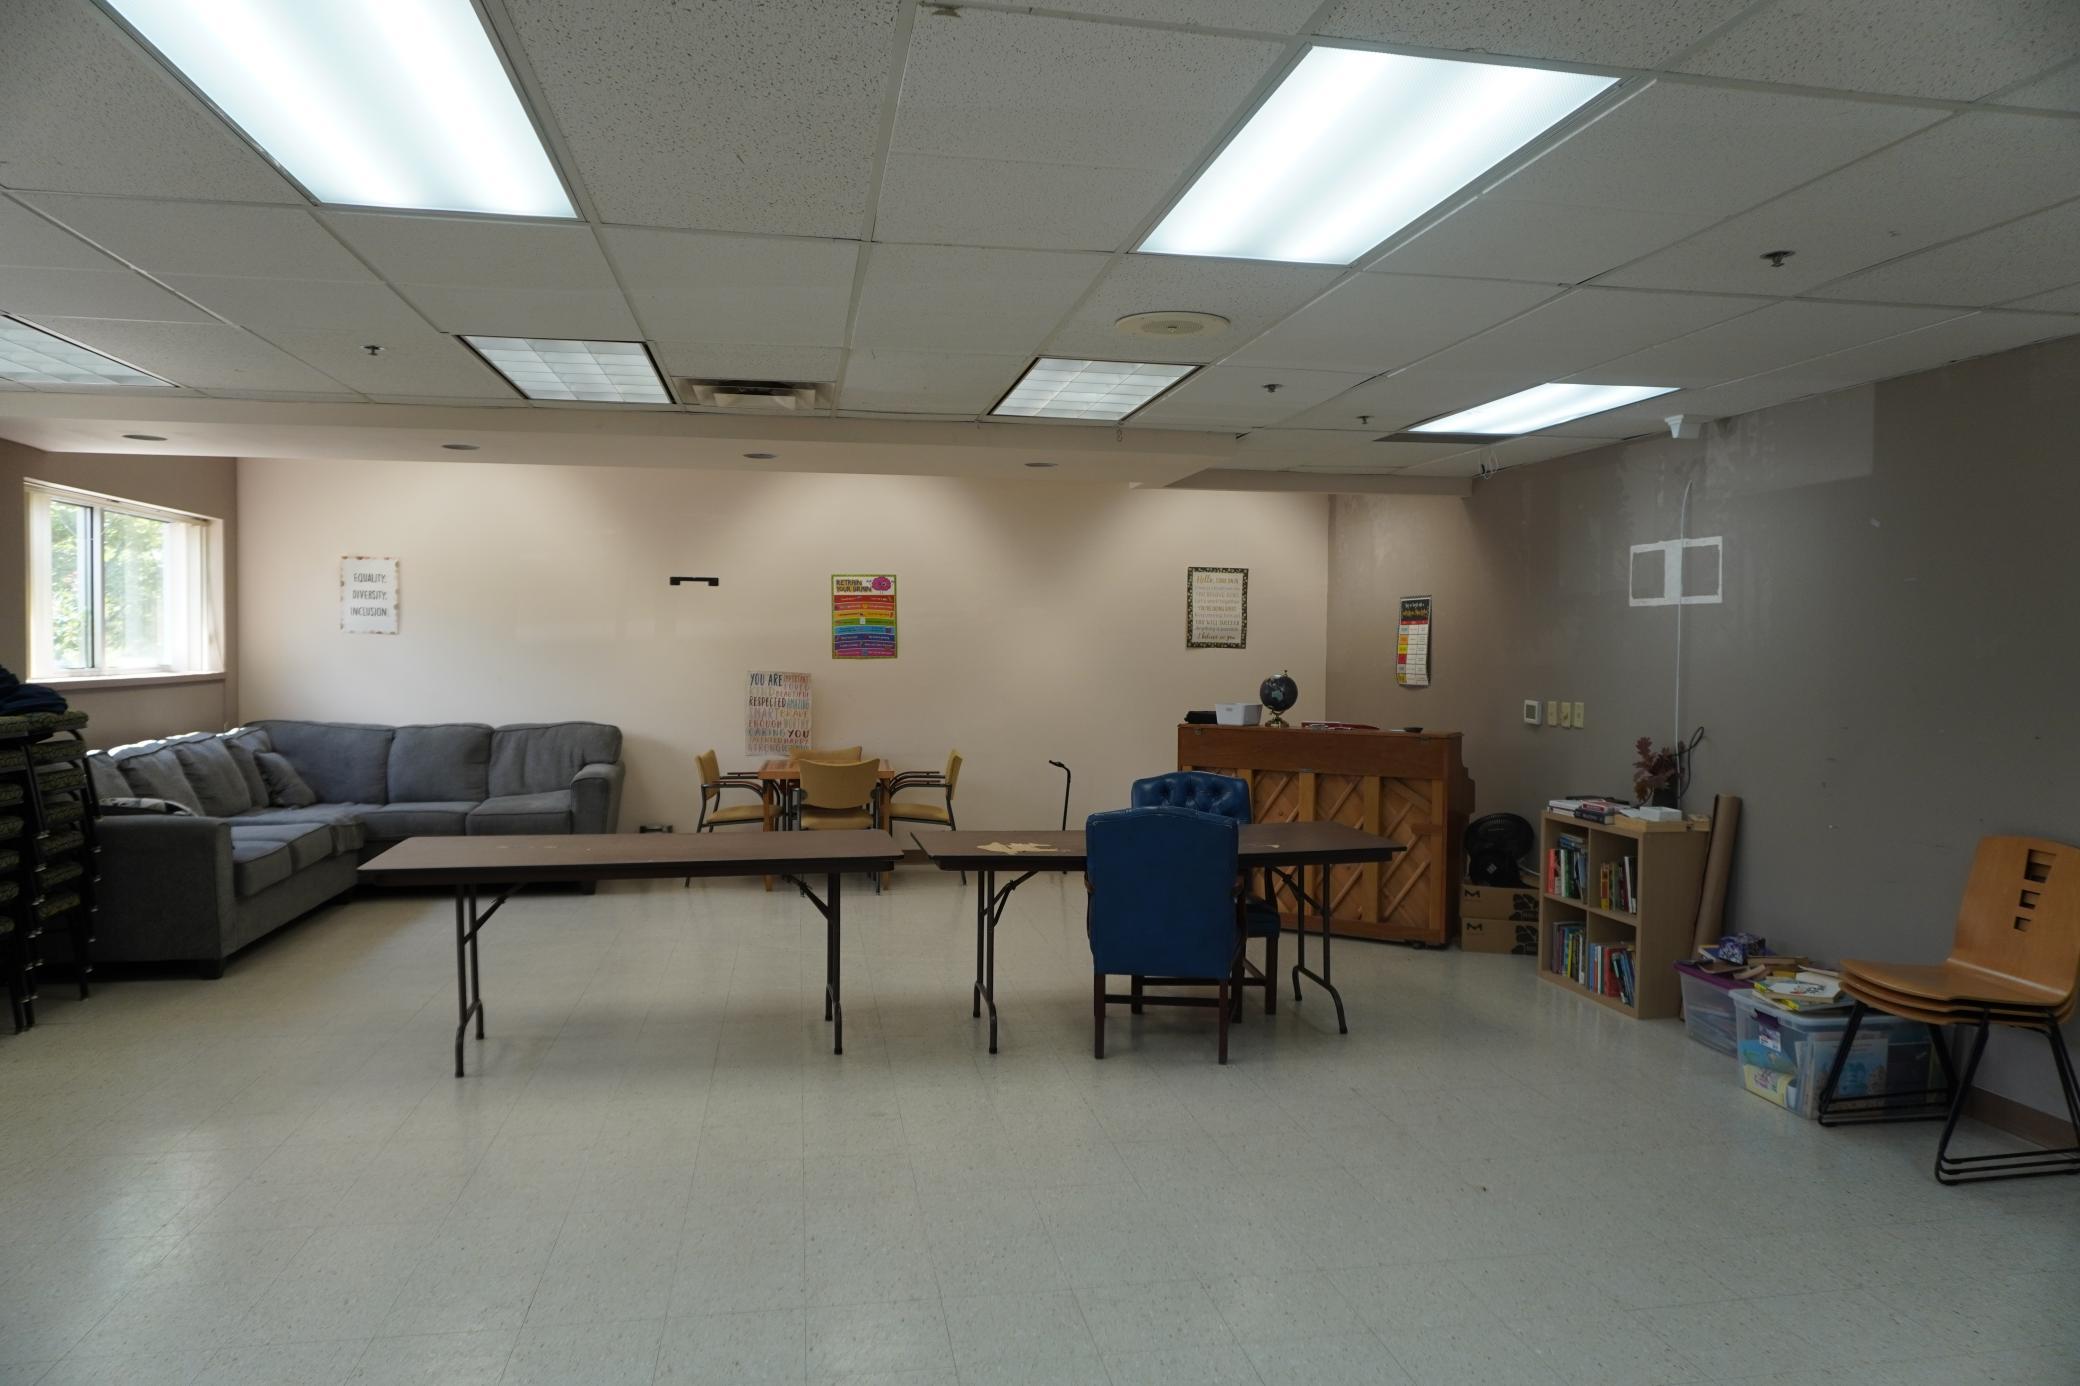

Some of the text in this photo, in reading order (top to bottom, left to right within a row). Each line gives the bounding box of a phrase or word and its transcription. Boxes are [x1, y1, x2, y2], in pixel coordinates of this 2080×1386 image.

[750, 673, 765, 687] YOU
[768, 673, 783, 687] ARE
[749, 696, 786, 708] RESPECTED
[787, 729, 810, 739] YOU
